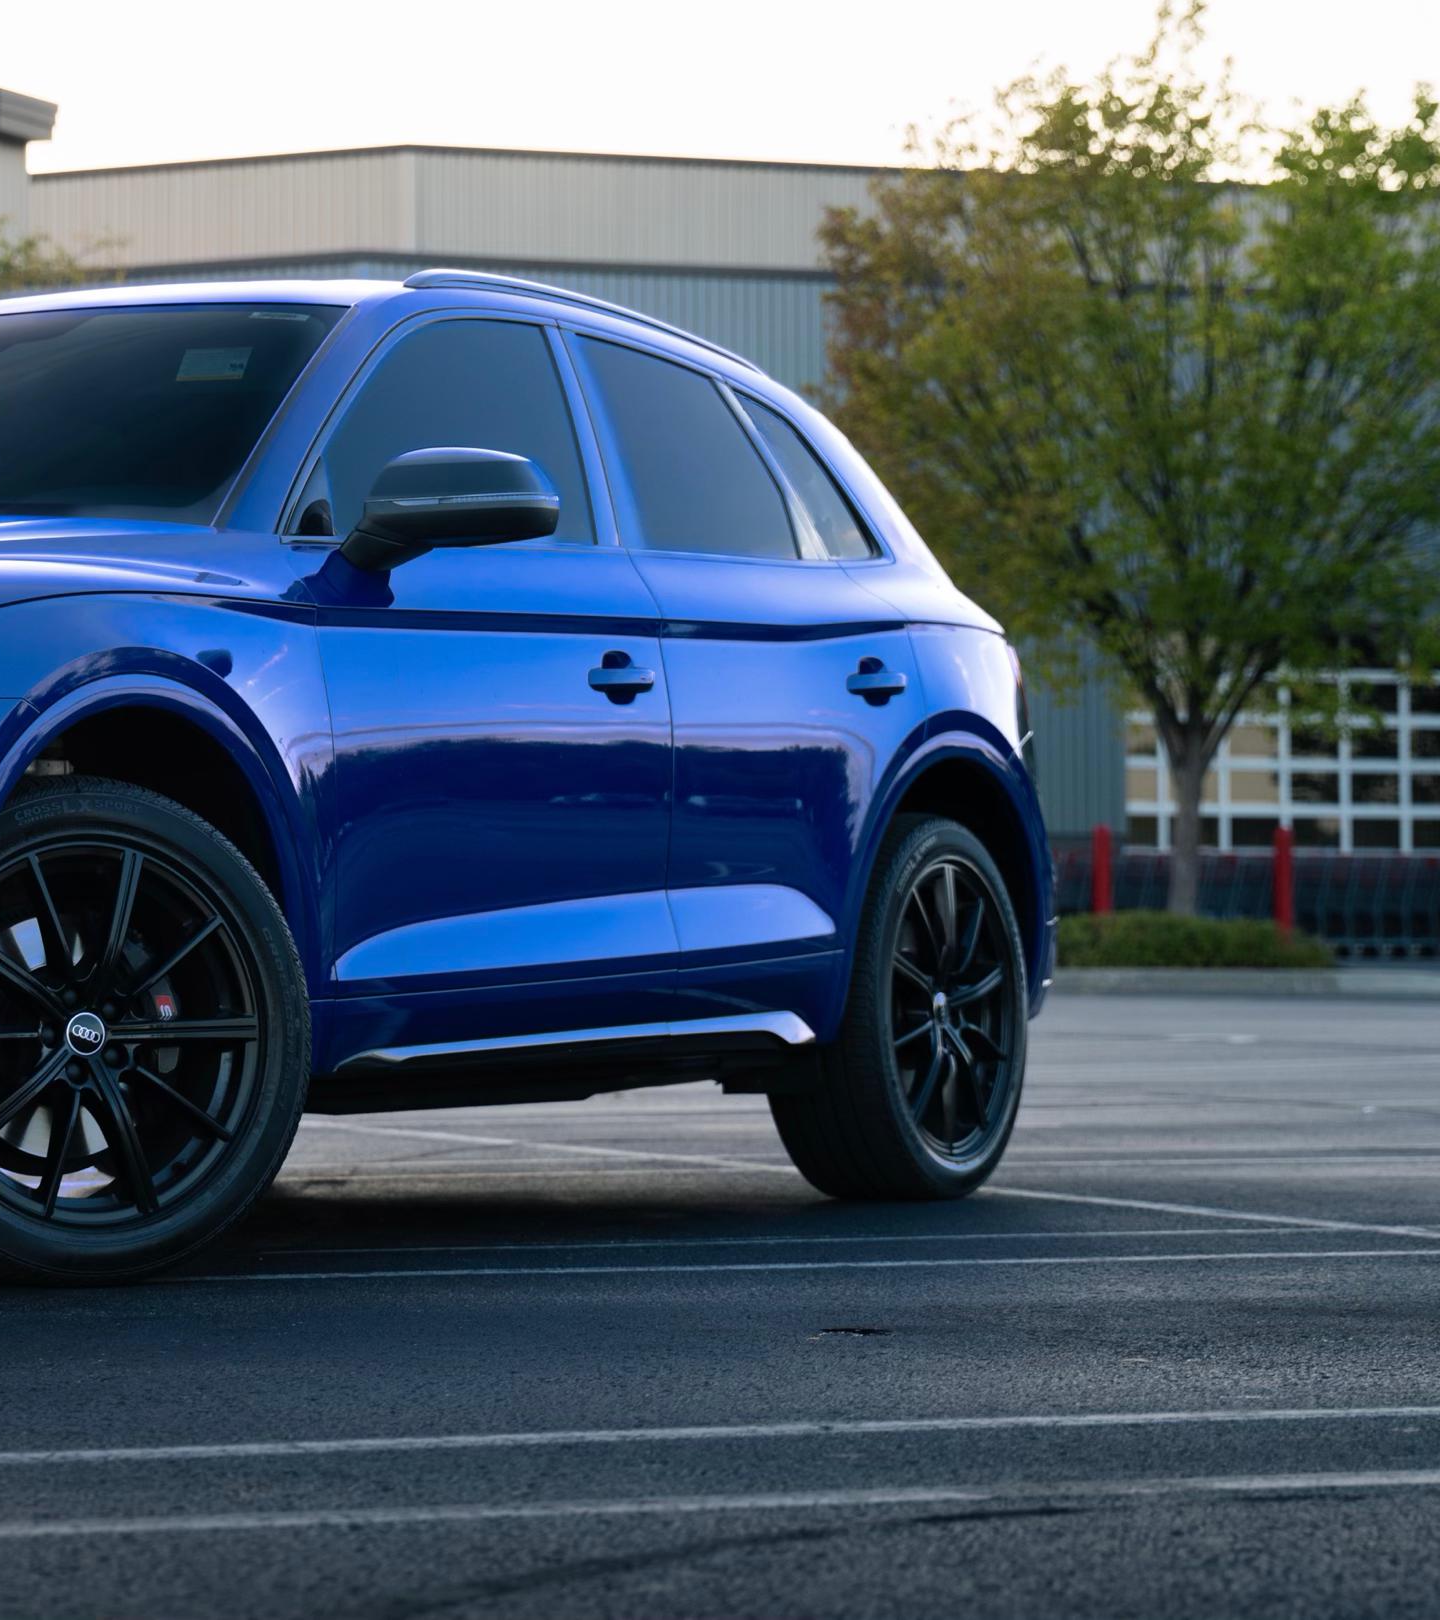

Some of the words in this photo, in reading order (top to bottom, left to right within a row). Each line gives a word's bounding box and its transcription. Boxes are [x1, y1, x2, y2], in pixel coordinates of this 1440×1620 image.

[15, 802, 61, 820] CROSS
[63, 799, 93, 812] LX
[95, 800, 141, 812] SPORT
